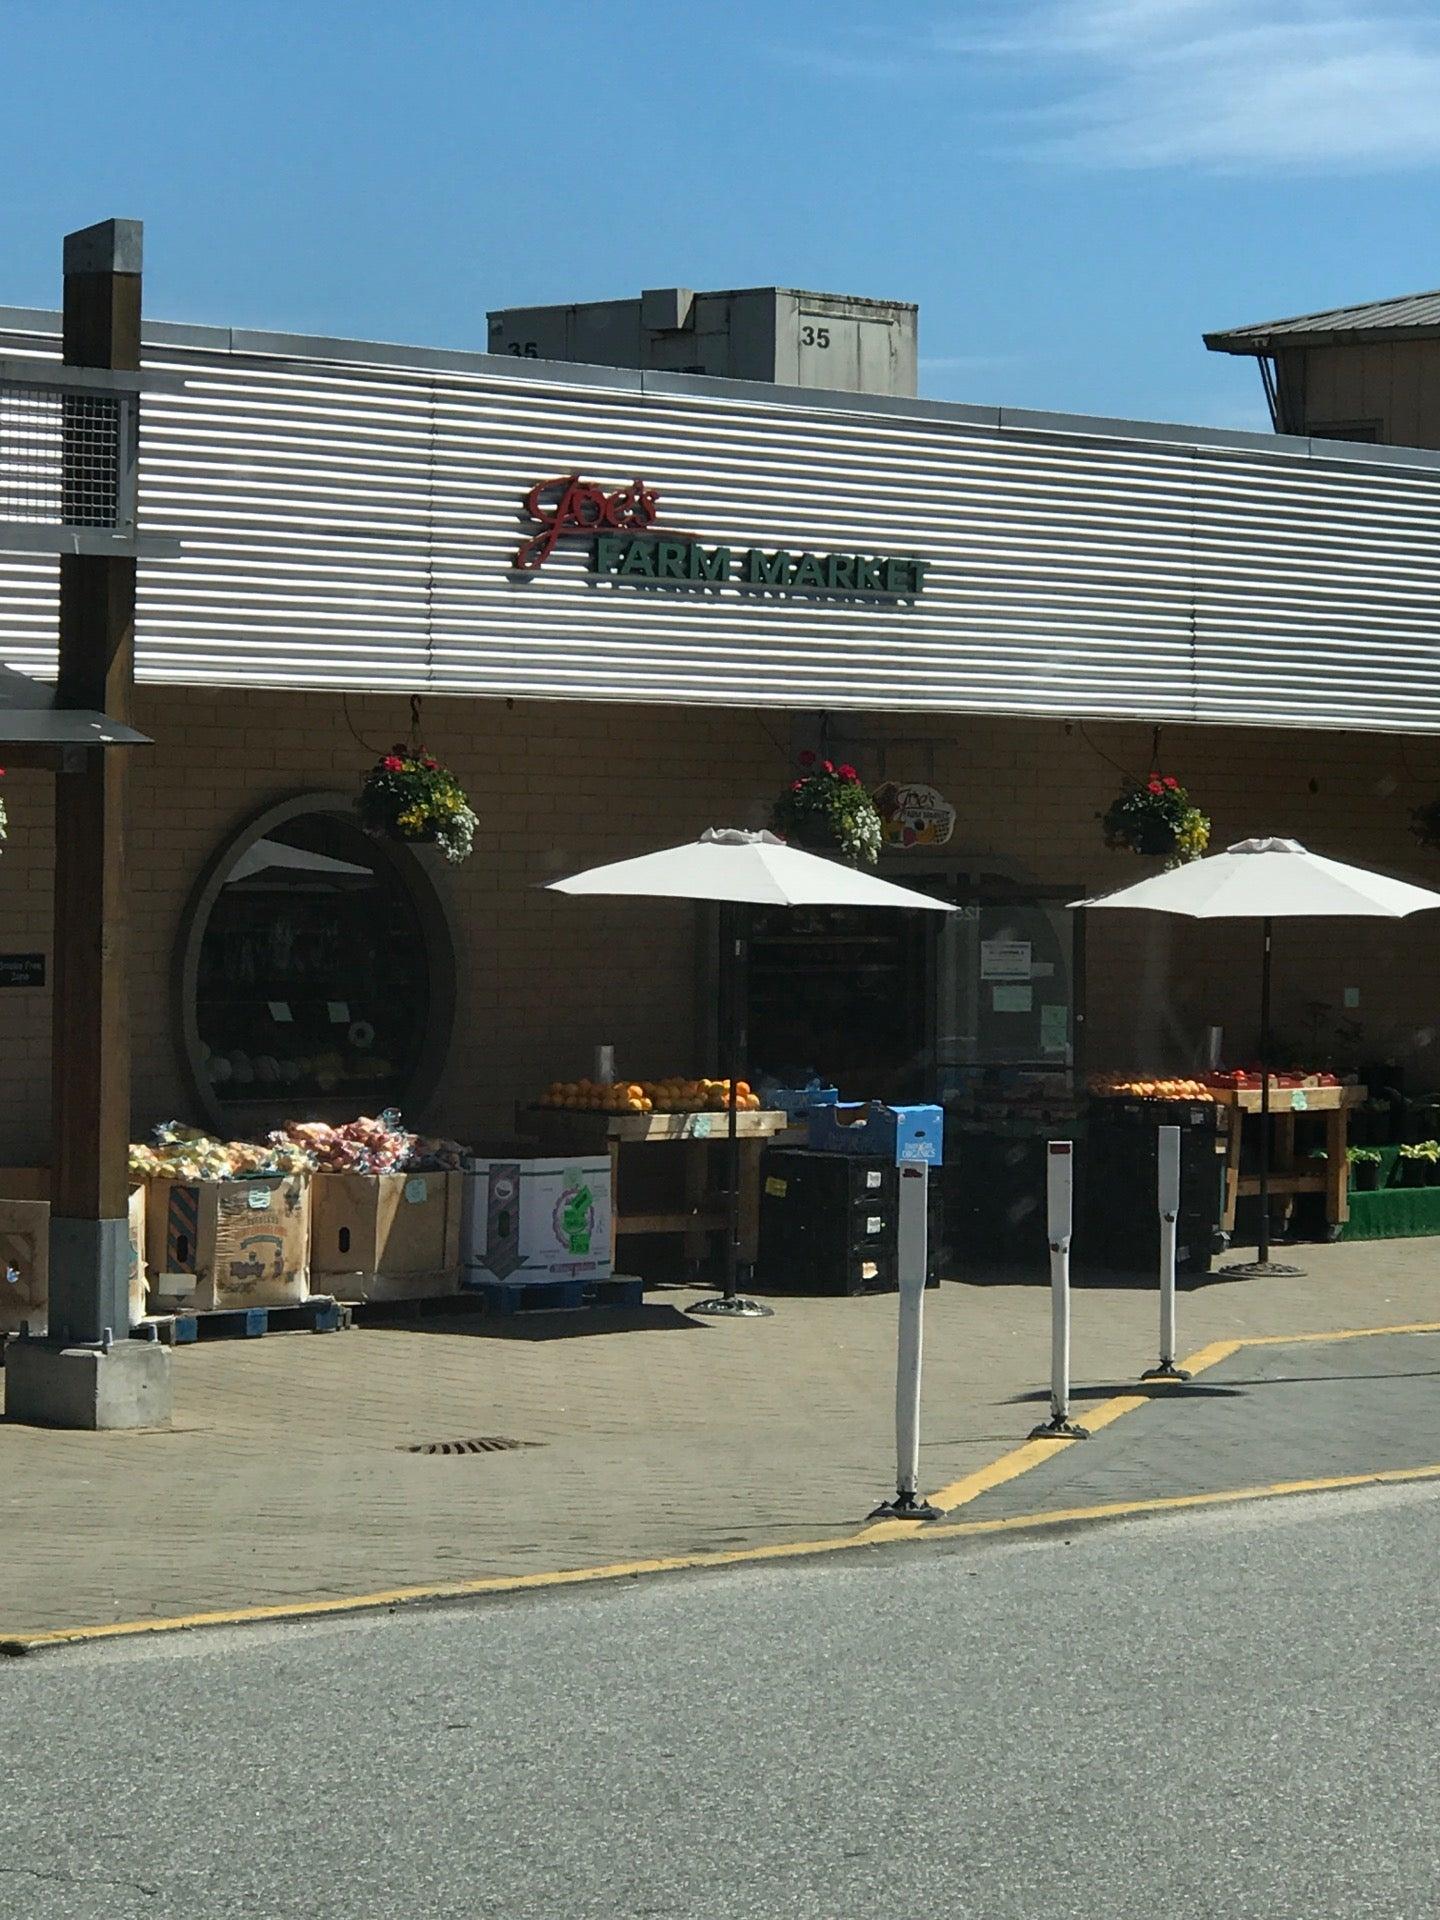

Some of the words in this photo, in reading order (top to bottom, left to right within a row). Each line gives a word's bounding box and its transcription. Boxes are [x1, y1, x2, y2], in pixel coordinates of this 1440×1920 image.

[508, 342, 539, 358] 35
[801, 326, 830, 349] 35
[517, 475, 660, 570] Joe's
[598, 536, 731, 582] FARM
[749, 549, 931, 593] MARKET
